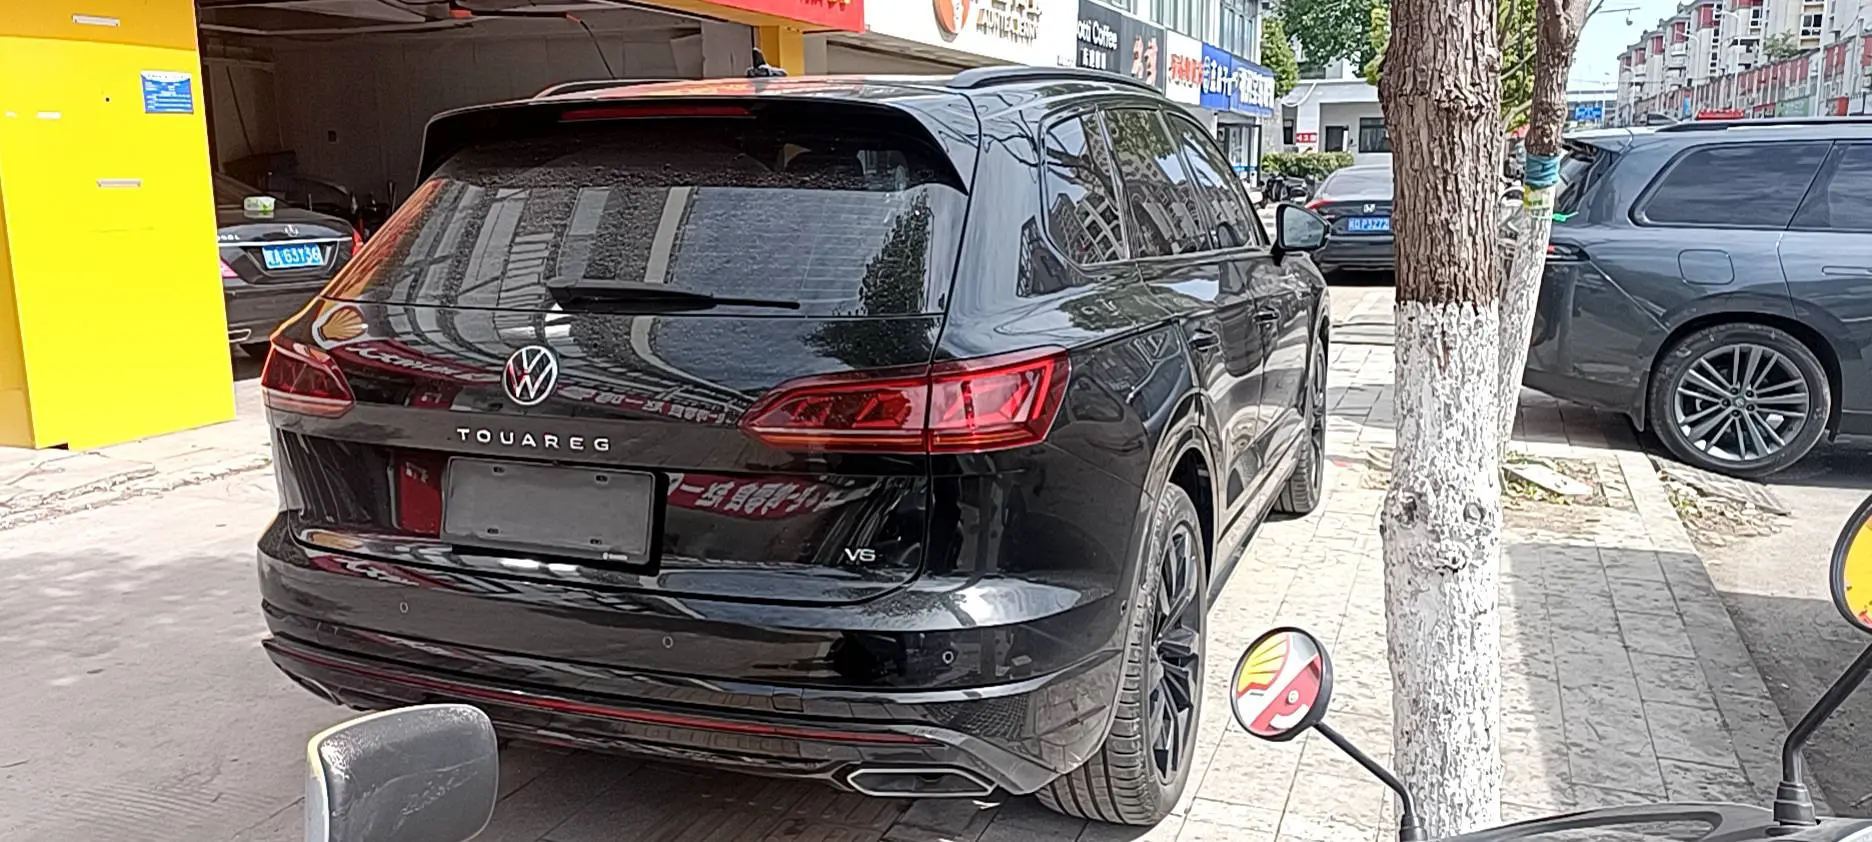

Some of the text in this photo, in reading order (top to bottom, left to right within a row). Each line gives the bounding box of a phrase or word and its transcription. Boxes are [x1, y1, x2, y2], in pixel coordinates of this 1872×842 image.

[1092, 20, 1118, 50] Coffee
[456, 428, 611, 452] TOUAREG
[844, 547, 876, 562] V6
